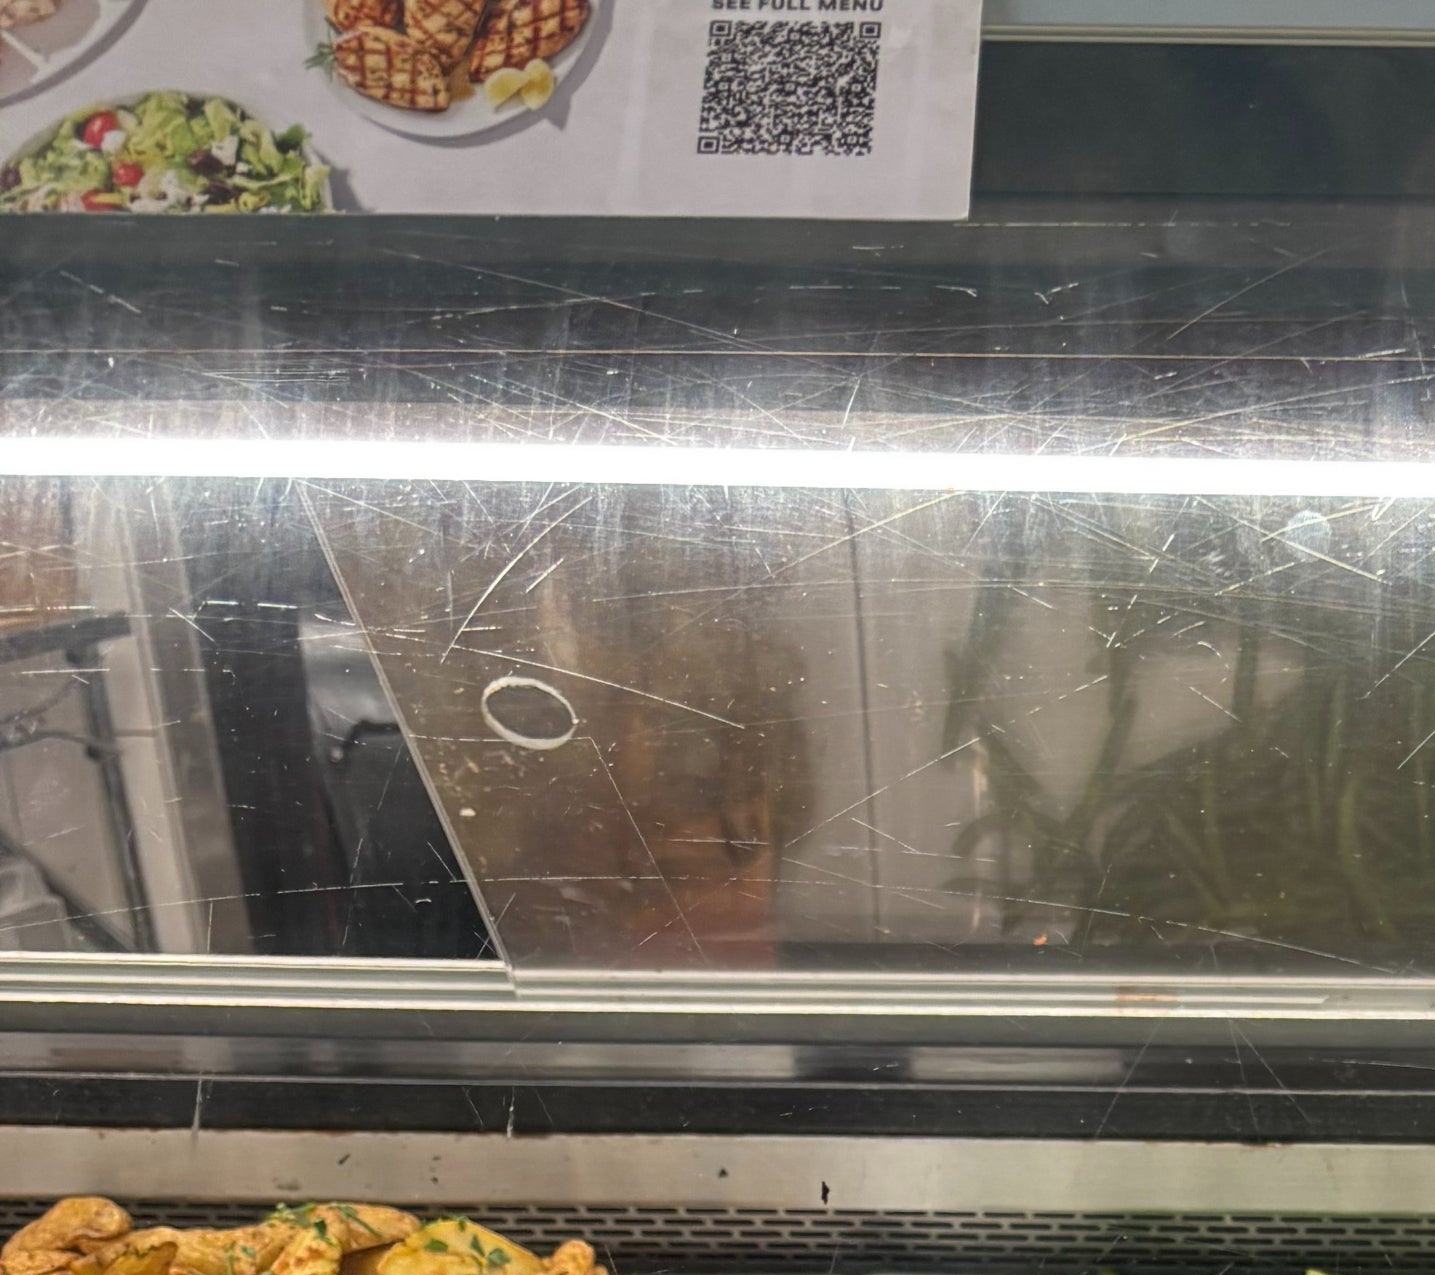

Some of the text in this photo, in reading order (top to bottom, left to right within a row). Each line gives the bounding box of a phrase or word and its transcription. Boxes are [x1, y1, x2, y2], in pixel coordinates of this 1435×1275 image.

[711, 0, 883, 12] SEE FULL MENU
